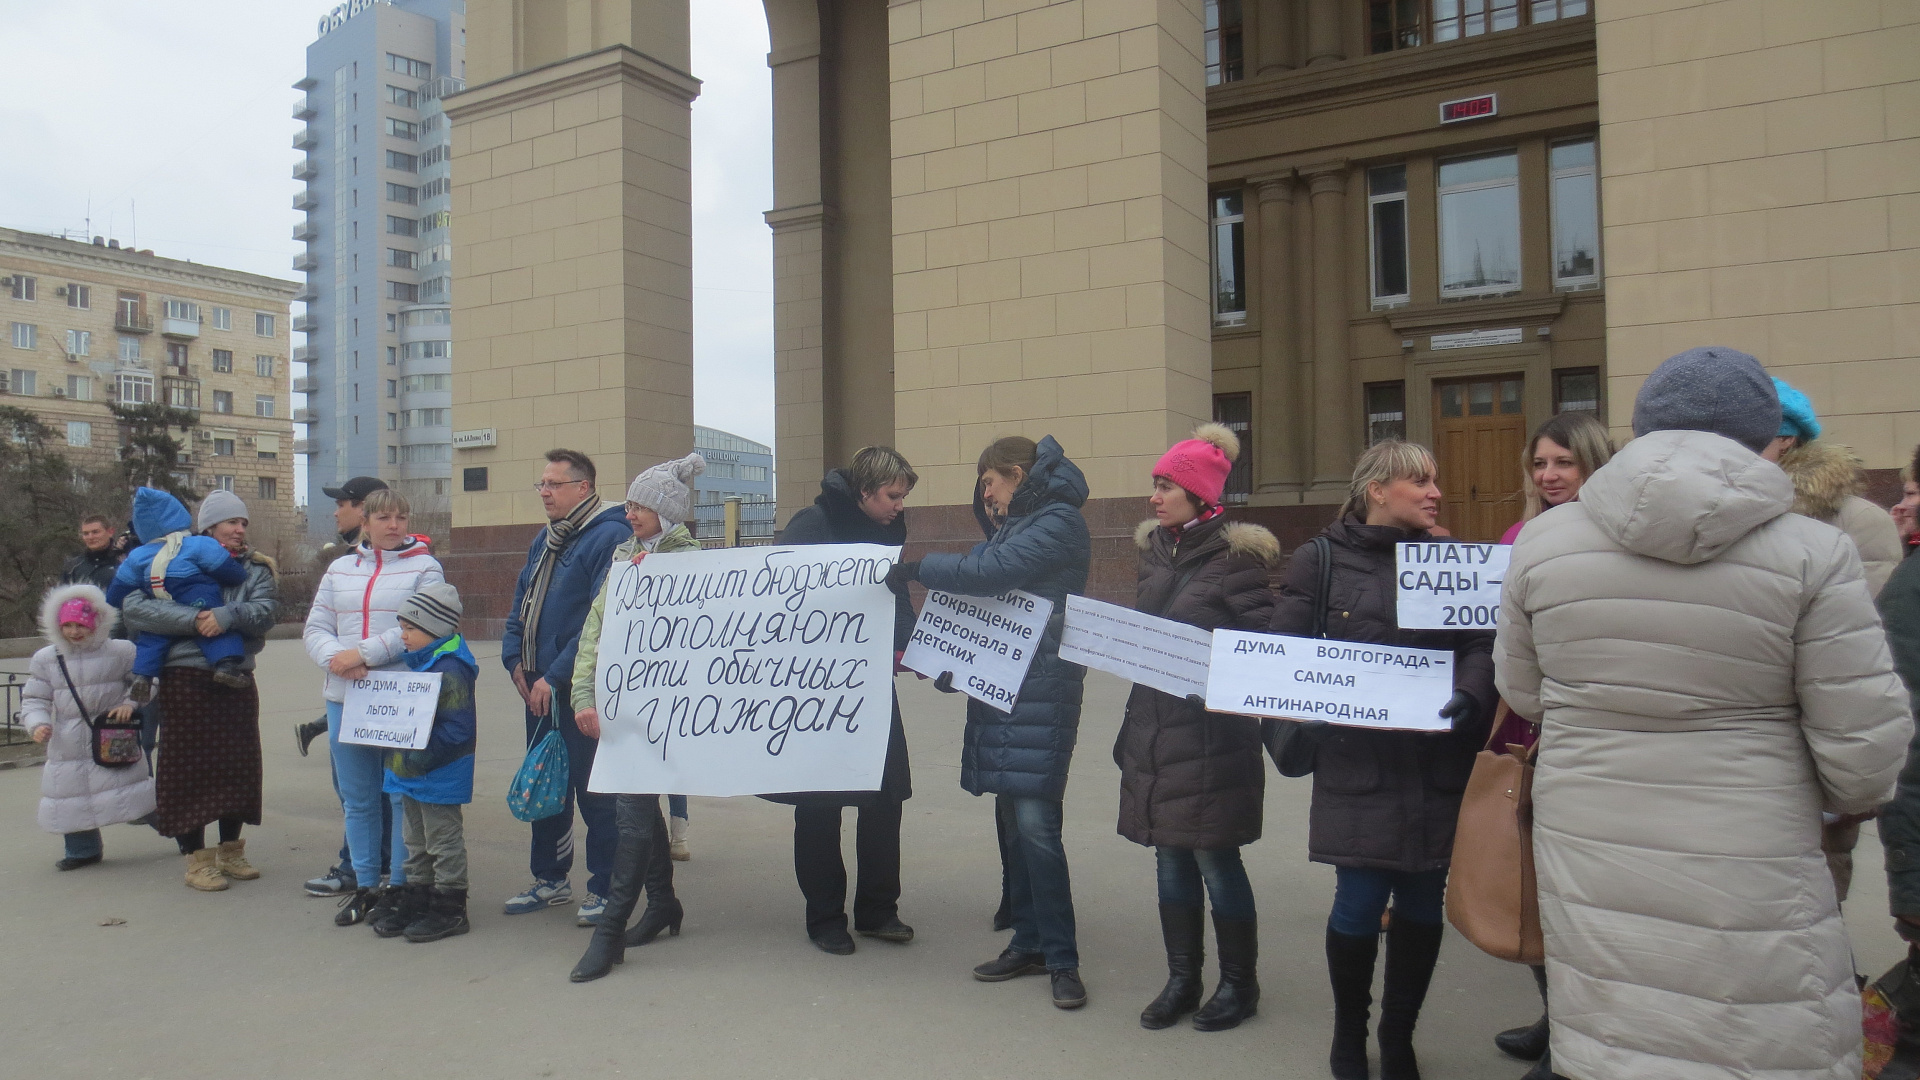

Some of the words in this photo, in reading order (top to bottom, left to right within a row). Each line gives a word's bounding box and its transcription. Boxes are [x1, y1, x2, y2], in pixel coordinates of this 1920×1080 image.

[707, 451, 741, 462] BUILDING
[1404, 543, 1493, 564] ПЛАТУ
[615, 563, 746, 617] Дефицит
[1399, 570, 1478, 595] САДЫ
[931, 591, 1033, 640] сокращение
[624, 608, 869, 655] пополняют
[911, 628, 977, 665] детских
[922, 610, 1010, 656] персонала
[1011, 648, 1023, 661] в
[1233, 639, 1286, 656] ДУМА
[1316, 644, 1430, 669] ВОЛГОГРАДА
[372, 680, 402, 695] ДУМА,
[407, 682, 432, 693] ВЕРНИ
[605, 659, 688, 721] дети
[707, 649, 868, 690] обычных
[967, 675, 1016, 705] садах
[1293, 669, 1356, 688] САМАЯ
[366, 704, 399, 717] ЛЬГОТЫ
[408, 706, 415, 717] И
[1243, 693, 1389, 721] АНТИНАРОДНАЯ
[353, 727, 418, 748] КОМПЕНСАЦИИ!
[636, 695, 865, 761] граждан
